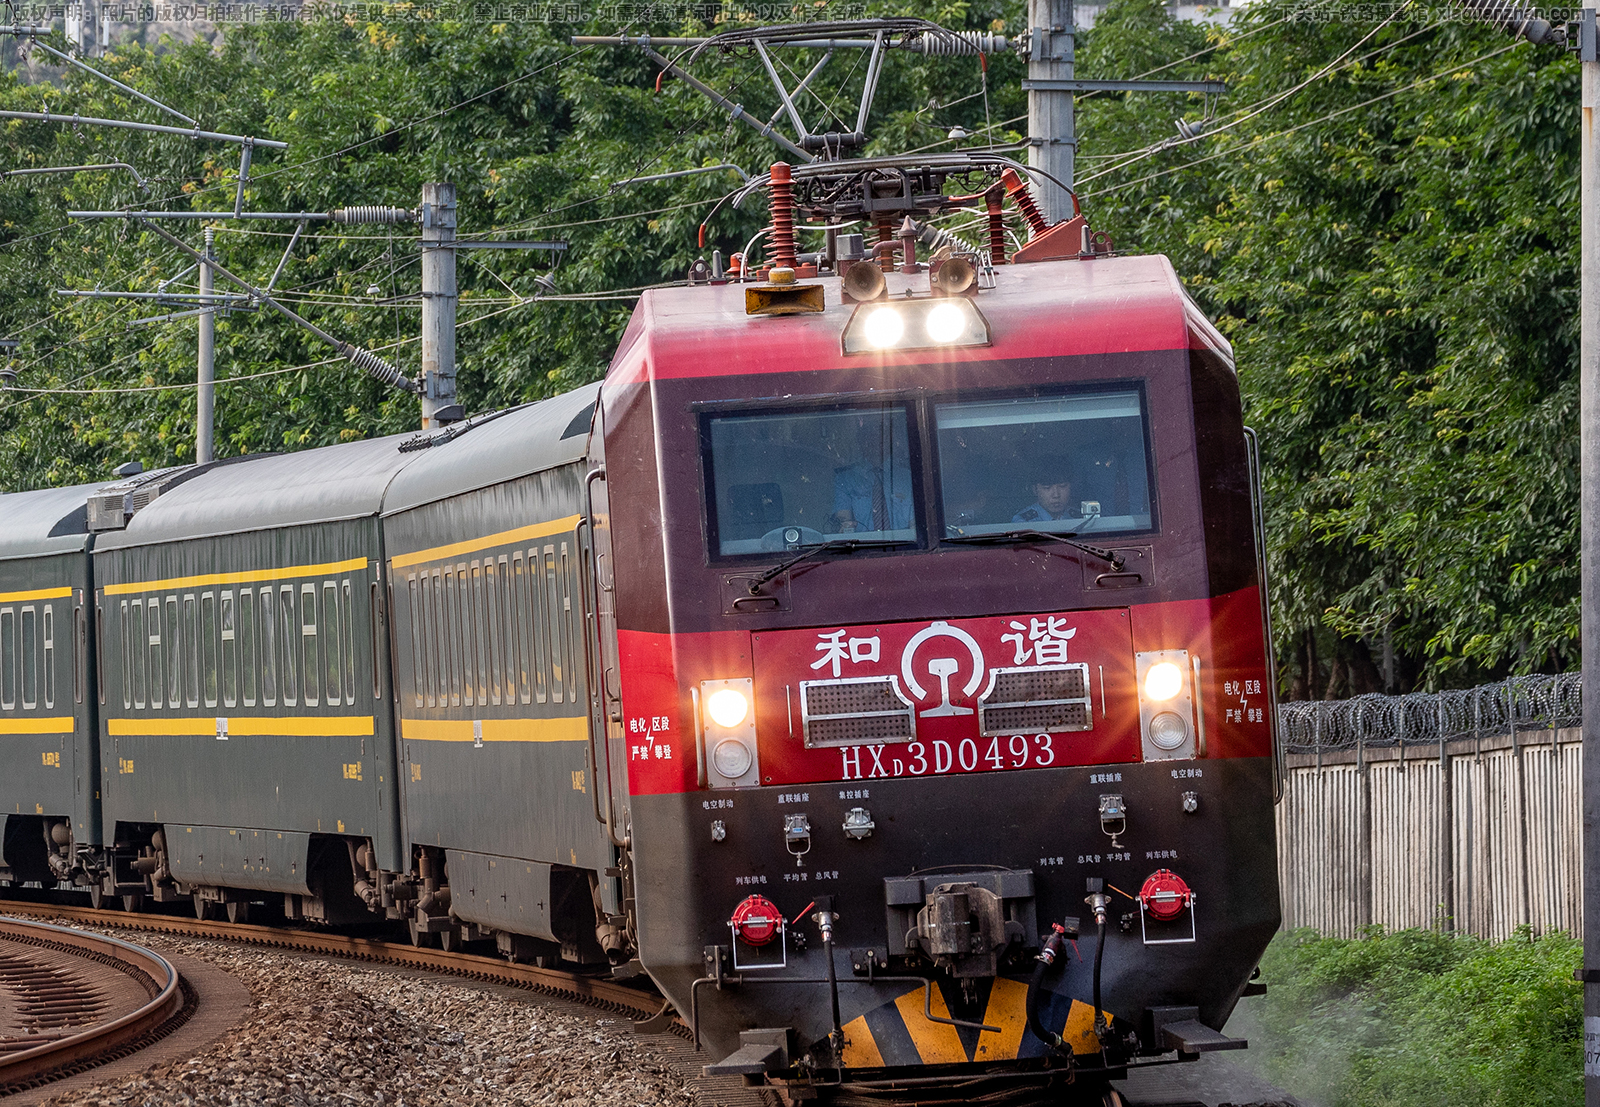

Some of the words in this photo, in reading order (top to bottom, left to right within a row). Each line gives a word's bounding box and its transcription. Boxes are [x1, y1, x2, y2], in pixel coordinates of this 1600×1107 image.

[810, 629, 881, 678] 和
[1001, 615, 1077, 665] 谐
[1224, 680, 1241, 696] 电化
[1245, 679, 1262, 695] 区段
[1225, 708, 1242, 724] 严禁
[1247, 708, 1263, 723] 攀登
[629, 717, 647, 733] 电化
[652, 716, 670, 731] 区段
[631, 745, 649, 761] 严禁
[654, 744, 672, 759] 攀登
[840, 733, 1055, 780] HXD3D0493
[1089, 772, 1123, 784] 重联插座
[1170, 767, 1203, 779] 电空制动
[702, 798, 734, 810] 电空制动
[777, 792, 810, 804] 重联插座
[1145, 849, 1178, 860] 列车供电
[735, 874, 768, 886] 列车供电
